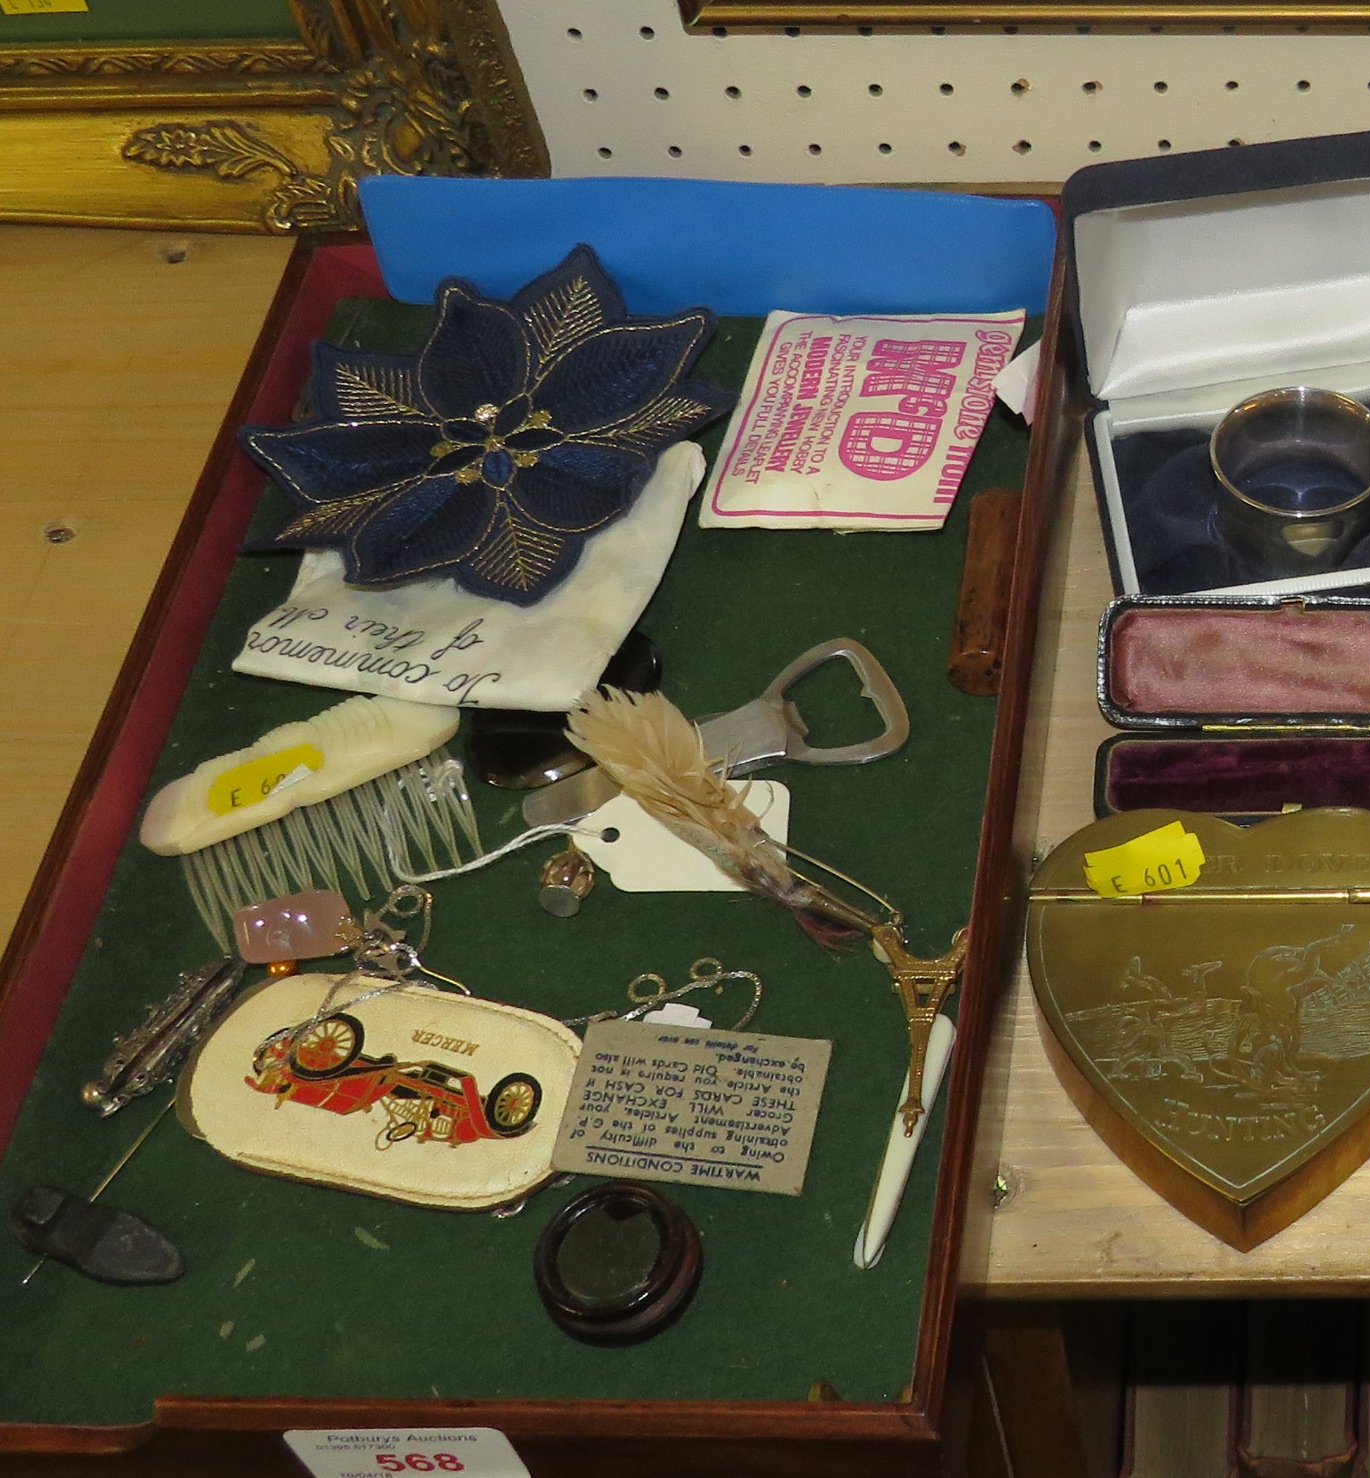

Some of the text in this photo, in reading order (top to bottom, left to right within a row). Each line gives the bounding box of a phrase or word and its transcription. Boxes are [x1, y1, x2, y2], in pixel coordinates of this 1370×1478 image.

[850, 336, 867, 362] YOUR
[732, 342, 793, 476] GIVES YOU FULL DETAILS
[746, 332, 812, 485] THE ACCOMPANYING LEAFLET
[764, 336, 833, 473] MODERN JEWELLERY
[791, 333, 851, 474] FASCINATING NEW HOBBY
[818, 364, 857, 445] INTRODUCTION
[810, 448, 827, 464] TO
[343, 614, 426, 653] their
[430, 618, 485, 661] of
[442, 671, 501, 706] To
[231, 788, 242, 808] E
[1111, 875, 1128, 894] E
[1143, 858, 1190, 888] 601
[411, 1029, 480, 1056] MERCER
[594, 1052, 621, 1065] also
[620, 1055, 647, 1068] will
[651, 1058, 689, 1073] Cards
[715, 1051, 806, 1074] be exchanged.
[590, 1064, 614, 1075] not
[637, 1069, 687, 1083] require
[692, 1063, 719, 1078] Old
[604, 1079, 646, 1094] CASH
[694, 1073, 720, 1087] you
[726, 1079, 773, 1095] Article
[655, 1084, 685, 1099] FOR
[692, 1089, 744, 1106] CARDS
[779, 1085, 801, 1098] the
[578, 1100, 613, 1114] your
[582, 1089, 794, 1124] Grocer WILL EXCHANGE
[751, 1095, 796, 1112] THESE
[611, 1119, 634, 1132] the
[640, 1122, 657, 1135] of
[693, 1114, 792, 1137] Advertisement
[1154, 1098, 1326, 1142] HUNTING
[664, 1125, 718, 1140] supplies
[724, 1129, 789, 1150] obtaining
[568, 1128, 786, 1164] Owing to the difficulty of
[585, 1150, 761, 1182] WARTIME CONDITIONS
[407, 1434, 477, 1443] Auctions
[375, 1453, 466, 1472] 568
